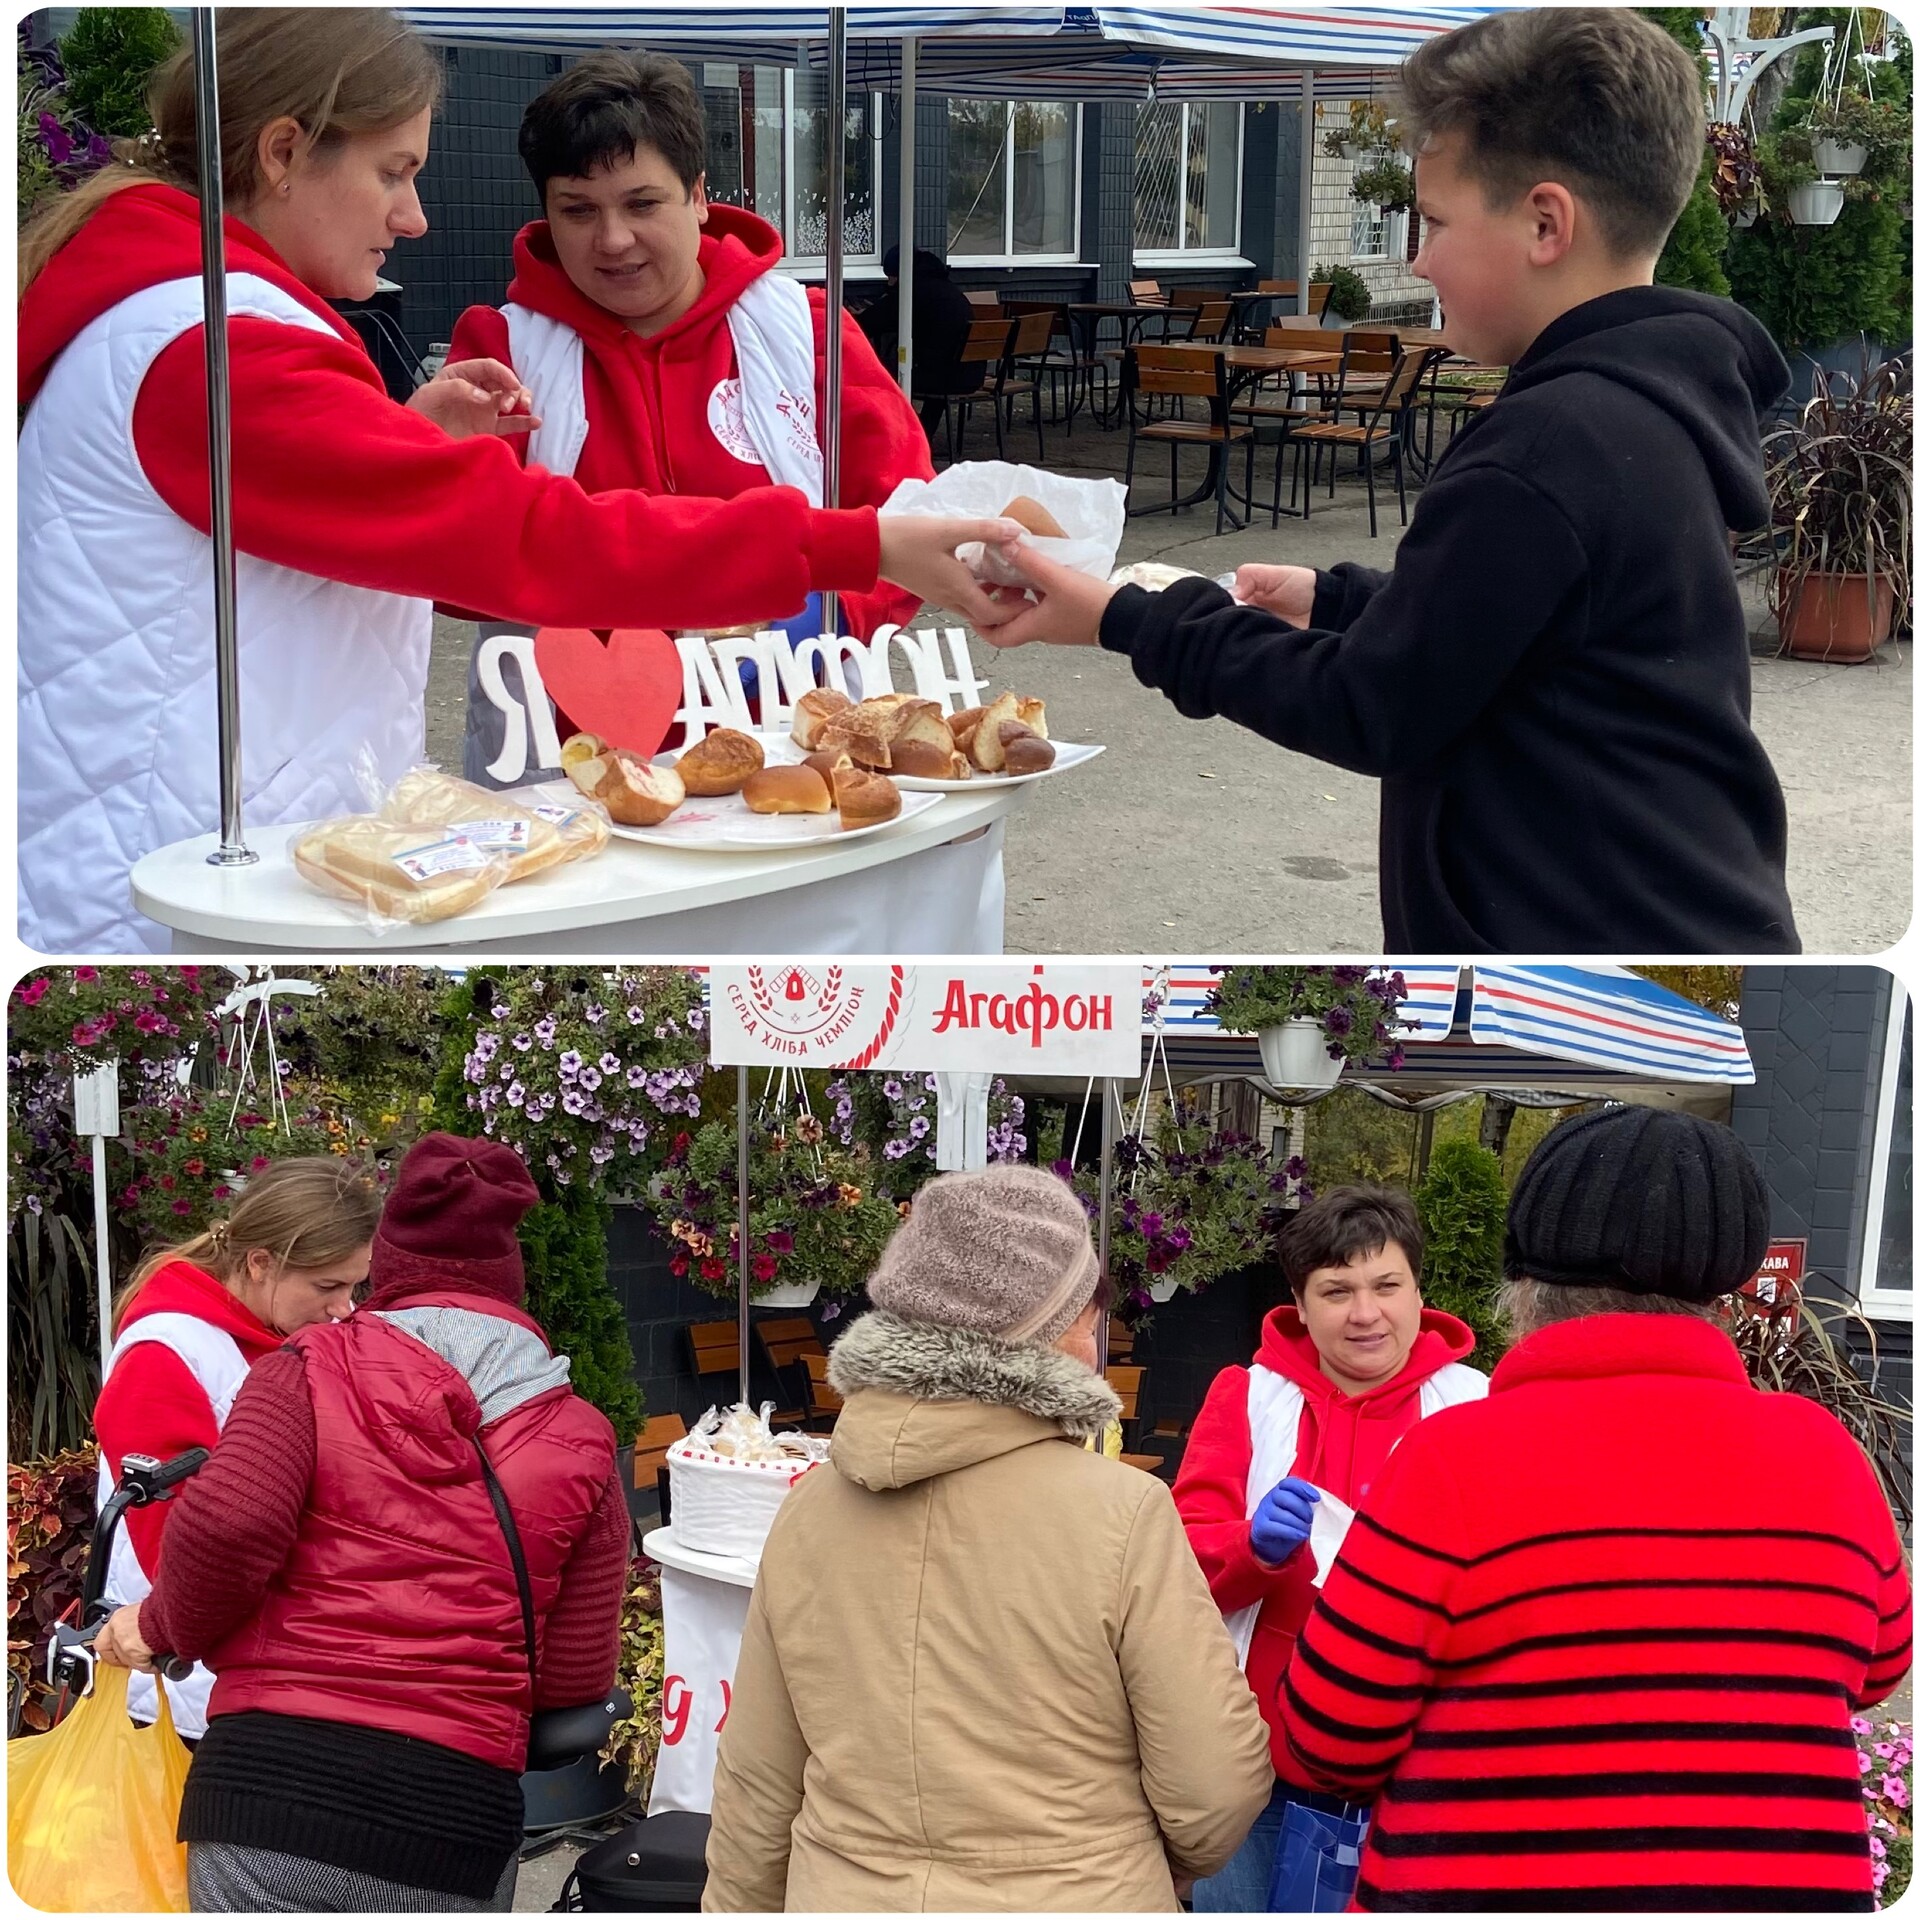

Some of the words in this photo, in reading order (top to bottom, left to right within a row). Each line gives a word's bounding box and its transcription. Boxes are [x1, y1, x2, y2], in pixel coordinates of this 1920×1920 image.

[478, 635, 566, 784] Я
[727, 984, 758, 1037] СЕРЕД
[761, 1030, 808, 1056] ХЛІБА
[814, 986, 865, 1049] ЧЕМПІОН
[931, 979, 1113, 1048] Агафон
